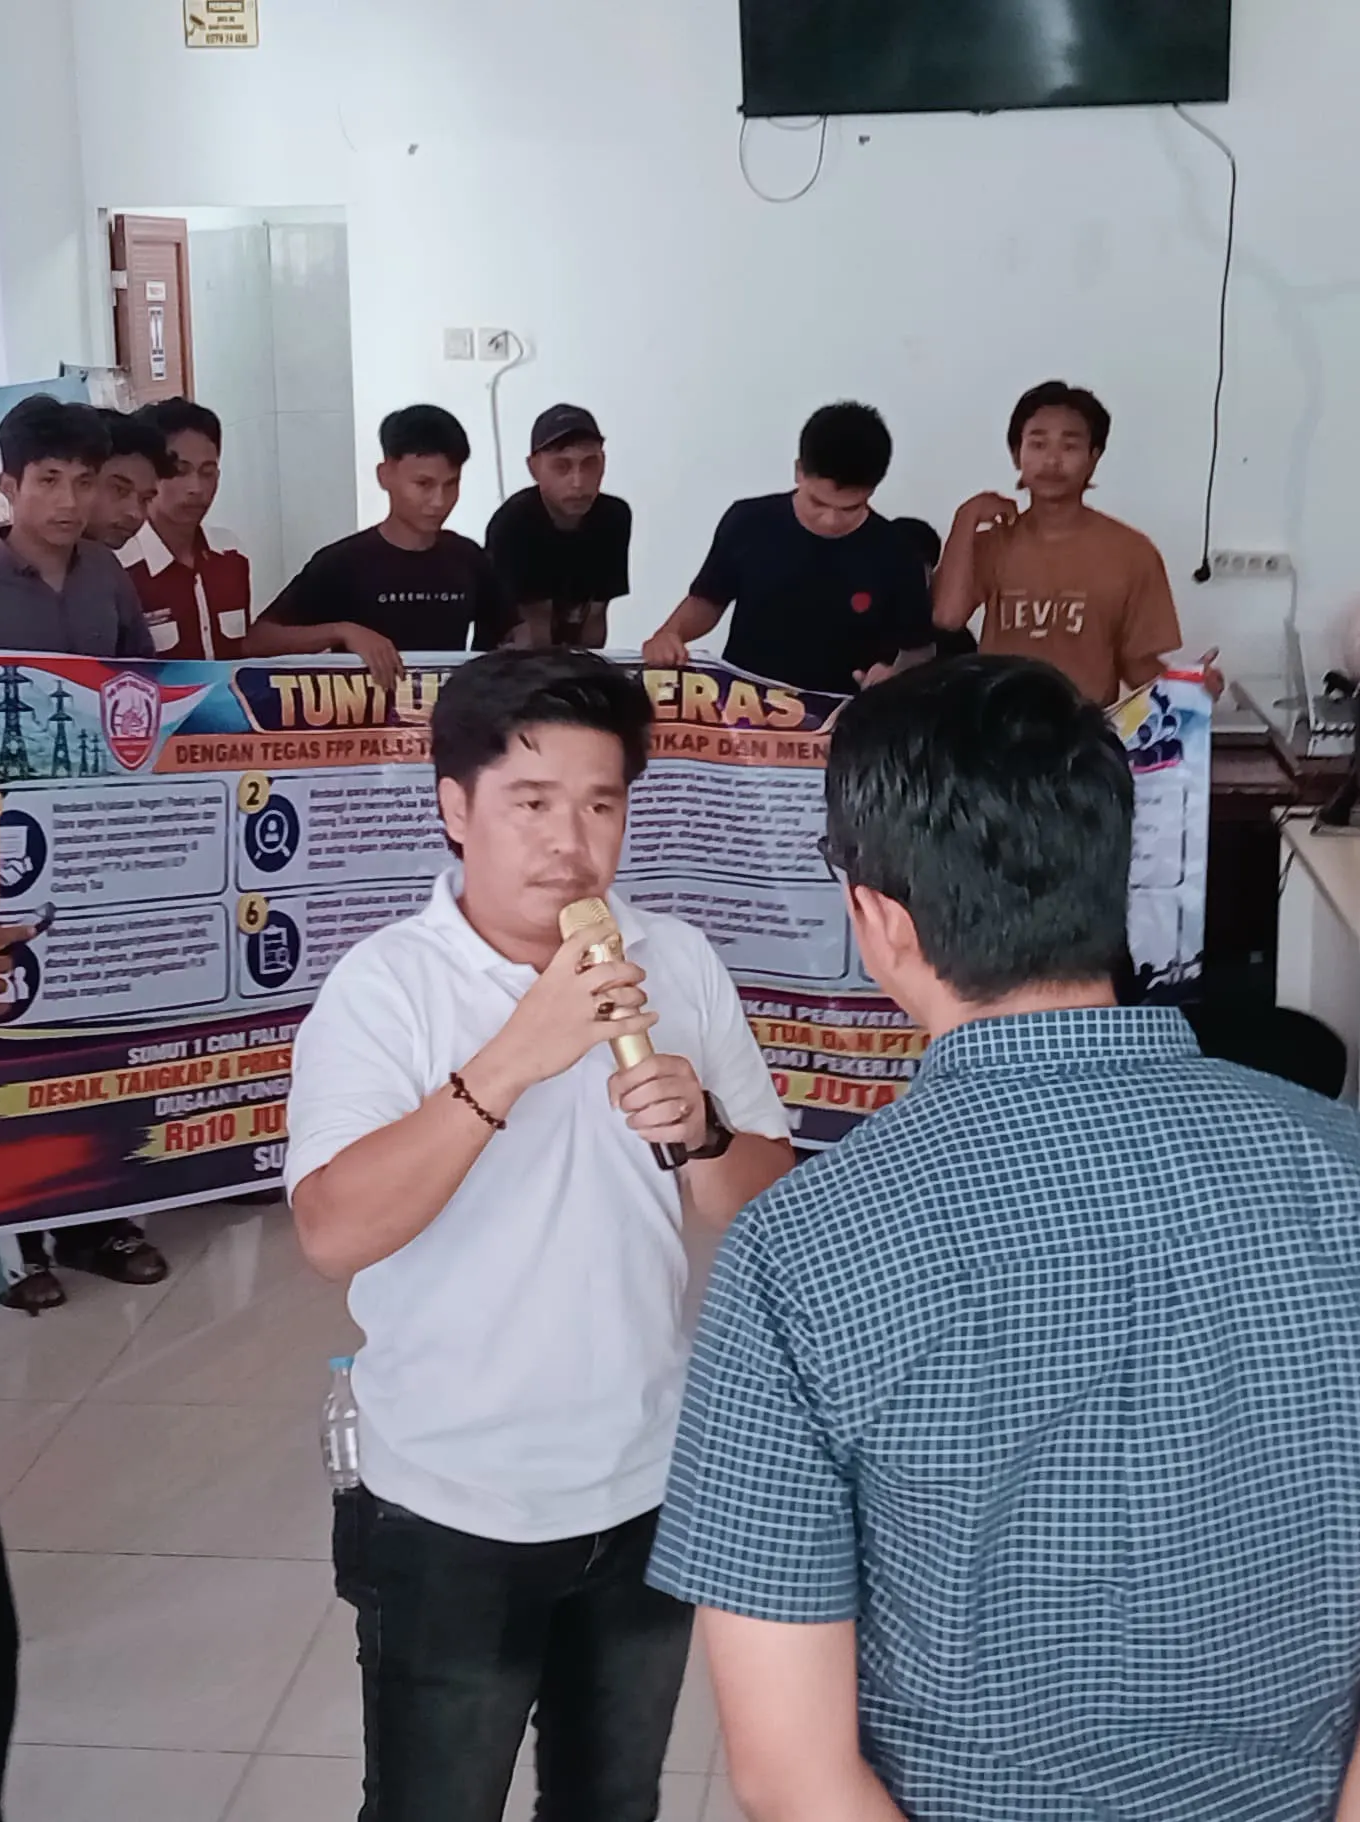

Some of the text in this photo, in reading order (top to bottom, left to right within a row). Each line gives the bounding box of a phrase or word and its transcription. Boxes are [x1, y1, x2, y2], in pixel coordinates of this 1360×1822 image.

[1000, 599, 1085, 634] LEVI'S
[269, 671, 452, 728] TUNTU
[176, 742, 254, 765] DENGAN
[260, 740, 321, 762] TEGAS
[326, 739, 355, 759] FPP
[718, 737, 768, 758] DAN
[246, 781, 260, 806] 2
[246, 900, 259, 925] 6
[27, 1078, 110, 1109] DESAK,
[116, 1060, 214, 1095] TANGKAP
[767, 1023, 814, 1046] TUA
[881, 1033, 912, 1054] PT
[127, 1040, 188, 1065] SUMUT
[194, 1038, 202, 1055] 1
[154, 1085, 237, 1117] DUGAAN
[812, 1053, 917, 1078] PEKERJA
[163, 1112, 236, 1153] Rp10
[804, 1076, 897, 1110] JUTA
